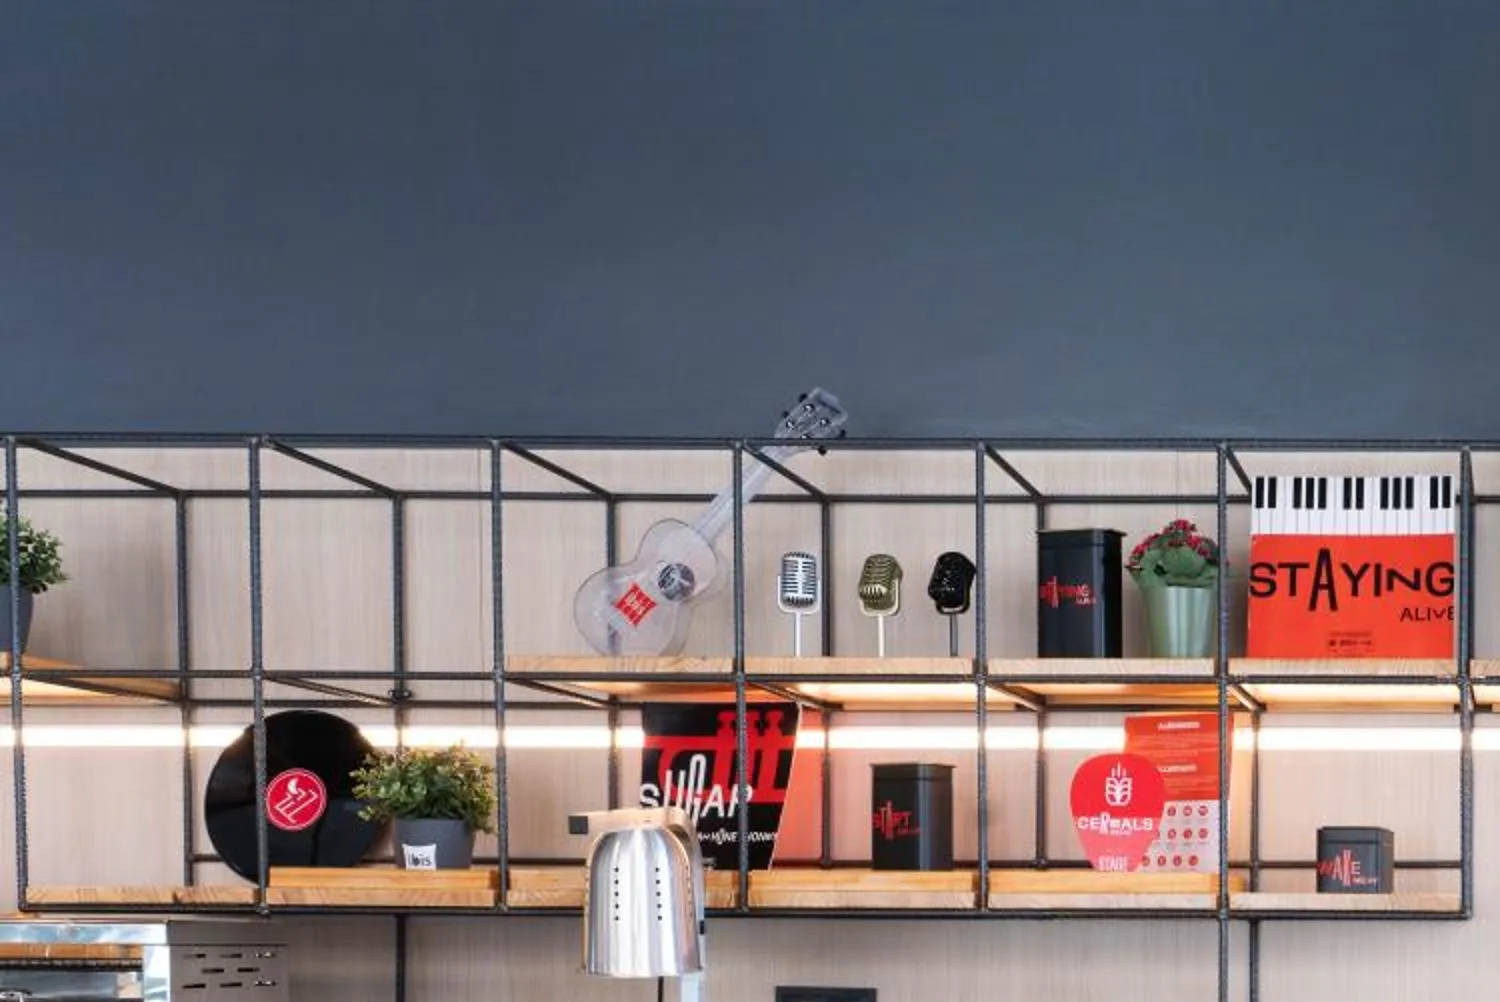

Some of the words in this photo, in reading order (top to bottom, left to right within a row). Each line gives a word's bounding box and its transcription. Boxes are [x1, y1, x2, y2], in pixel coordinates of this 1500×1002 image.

[1250, 548, 1454, 612] STAYING
[1400, 607, 1454, 622] ALIVE
[1317, 849, 1360, 886] WAKE
